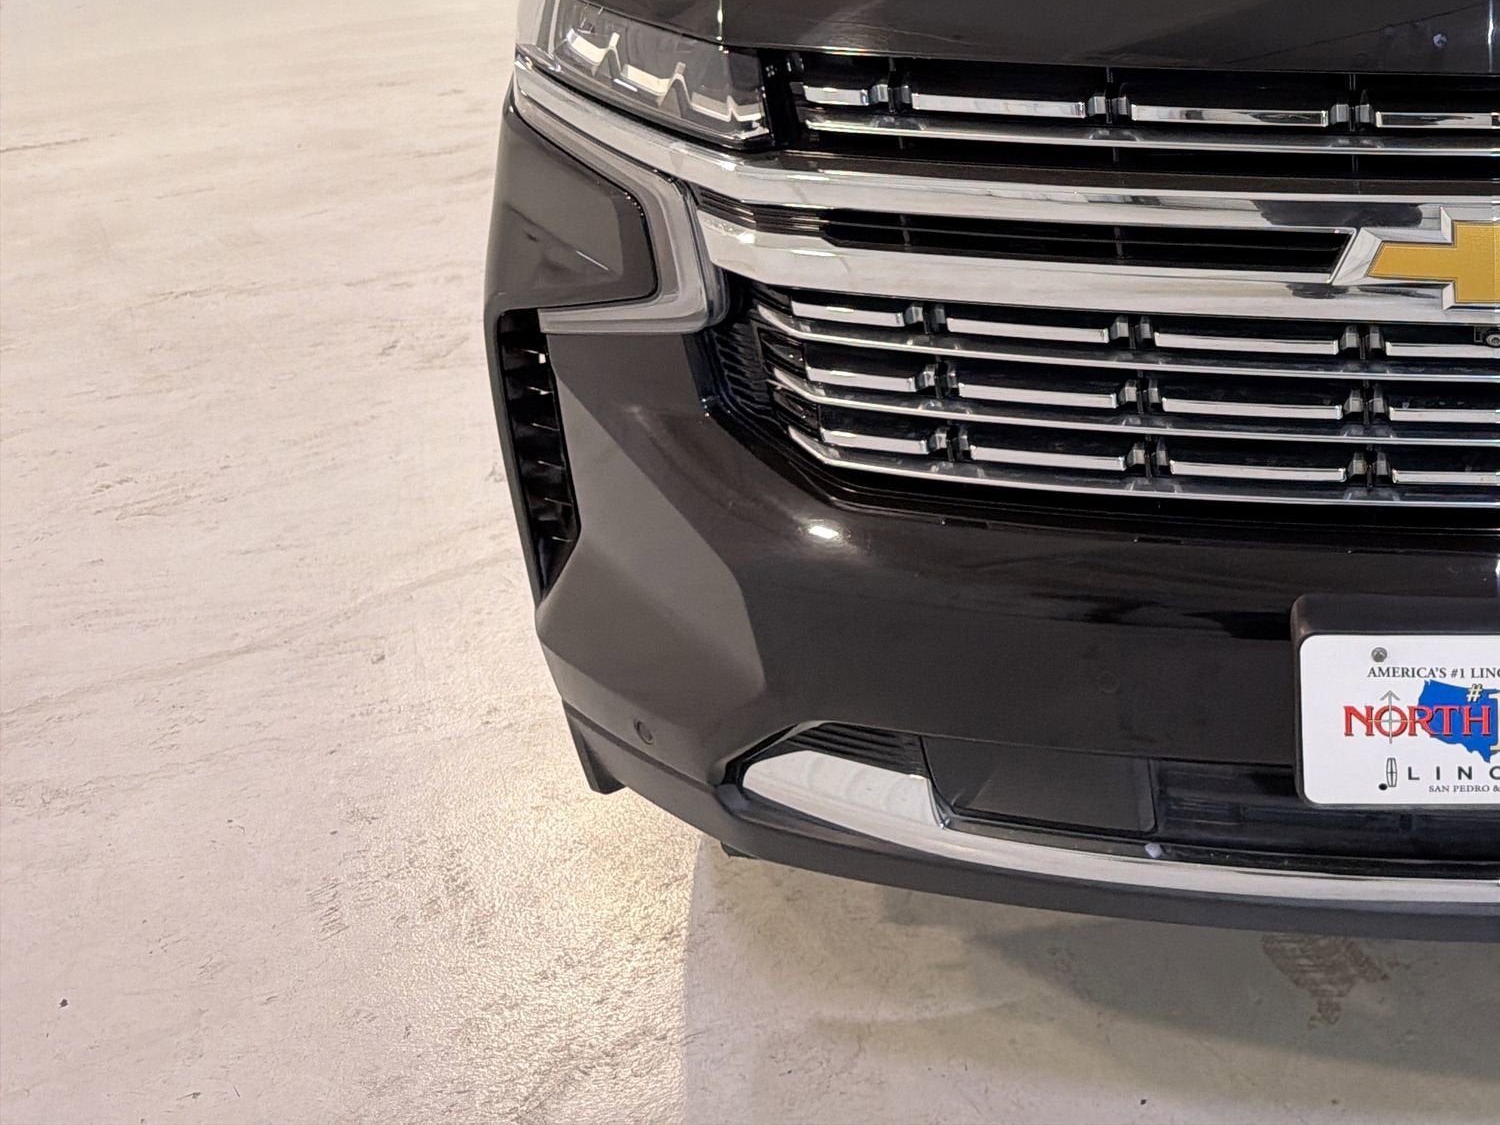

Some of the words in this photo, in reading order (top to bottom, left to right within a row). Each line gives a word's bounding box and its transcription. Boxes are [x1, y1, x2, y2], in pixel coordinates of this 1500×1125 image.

[1367, 666, 1447, 679] AMERICA'S
[1450, 667, 1465, 679] #1
[1343, 705, 1491, 737] NORTH
[1428, 784, 1450, 793] SAN
[1453, 784, 1490, 793] PEDRO
[1493, 784, 1500, 793] &
